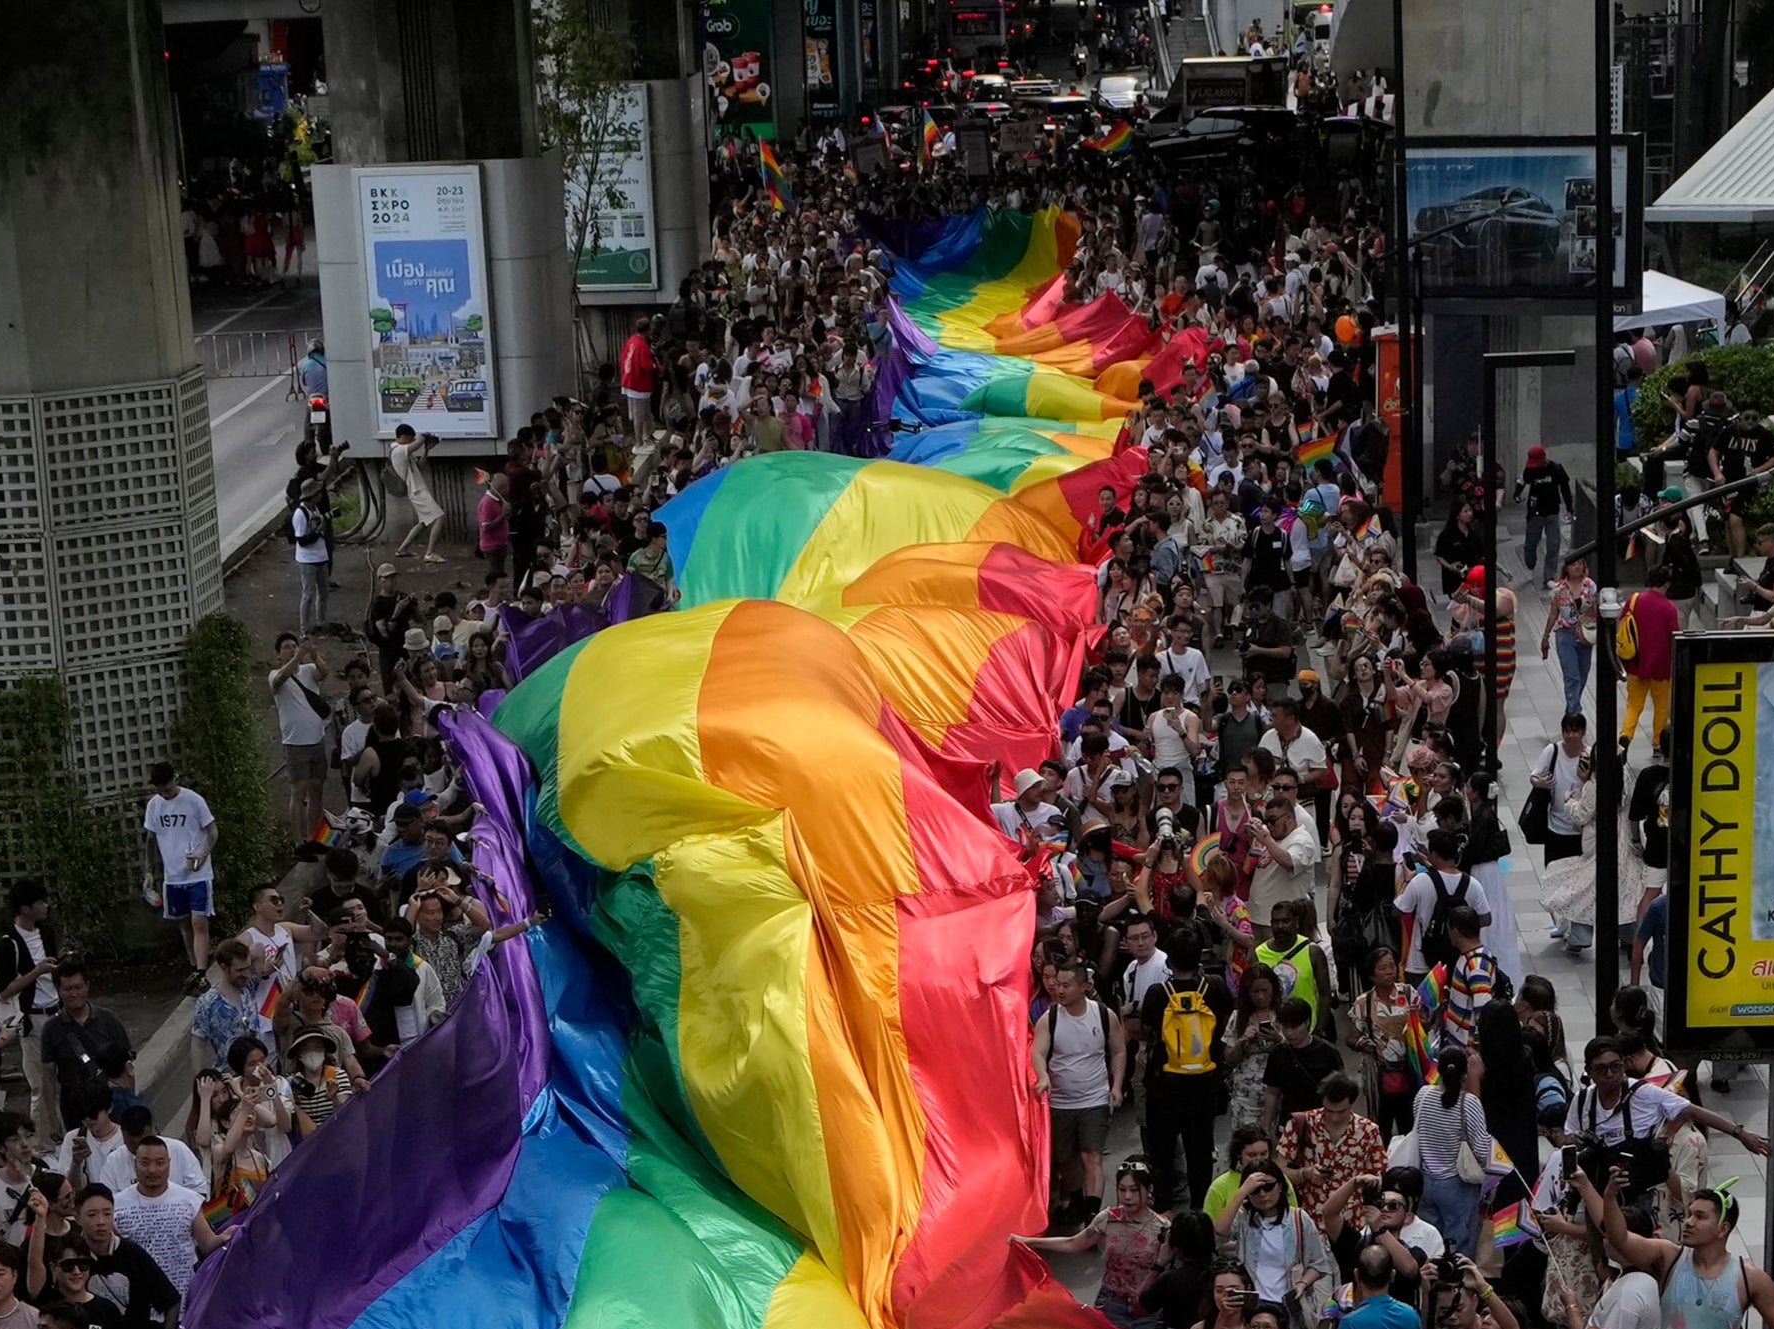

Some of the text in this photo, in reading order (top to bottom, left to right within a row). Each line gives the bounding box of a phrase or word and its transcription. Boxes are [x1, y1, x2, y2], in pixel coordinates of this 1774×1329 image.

[706, 18, 732, 32] Grab
[436, 186, 464, 196] 20-23
[372, 213, 410, 224] 2024
[386, 259, 426, 279] เมือง
[425, 277, 456, 299] คุณ
[159, 813, 187, 828] 1977
[1697, 670, 1743, 979] CATHY DOLL
